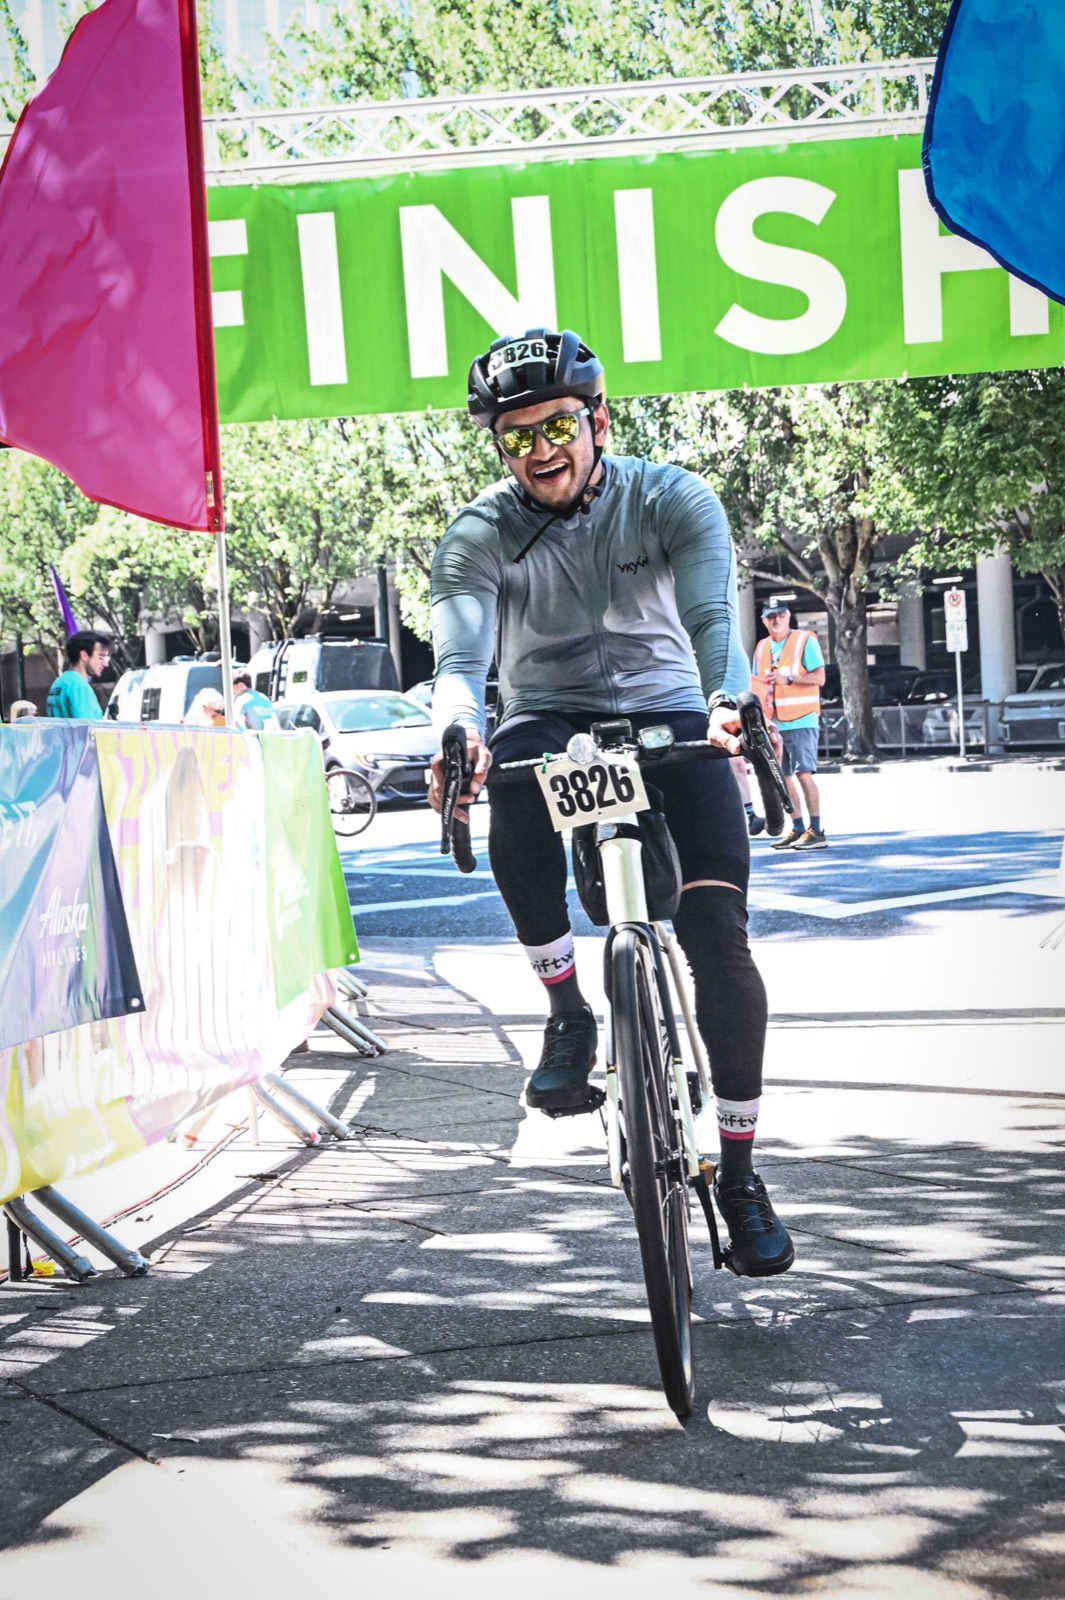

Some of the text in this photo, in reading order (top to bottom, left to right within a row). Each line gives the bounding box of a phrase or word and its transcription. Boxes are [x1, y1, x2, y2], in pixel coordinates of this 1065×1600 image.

[209, 167, 1051, 387] INISH
[489, 341, 545, 371] 3826
[549, 764, 635, 817] 3826
[39, 886, 89, 939] Alaska
[42, 945, 87, 968] AIRLINES
